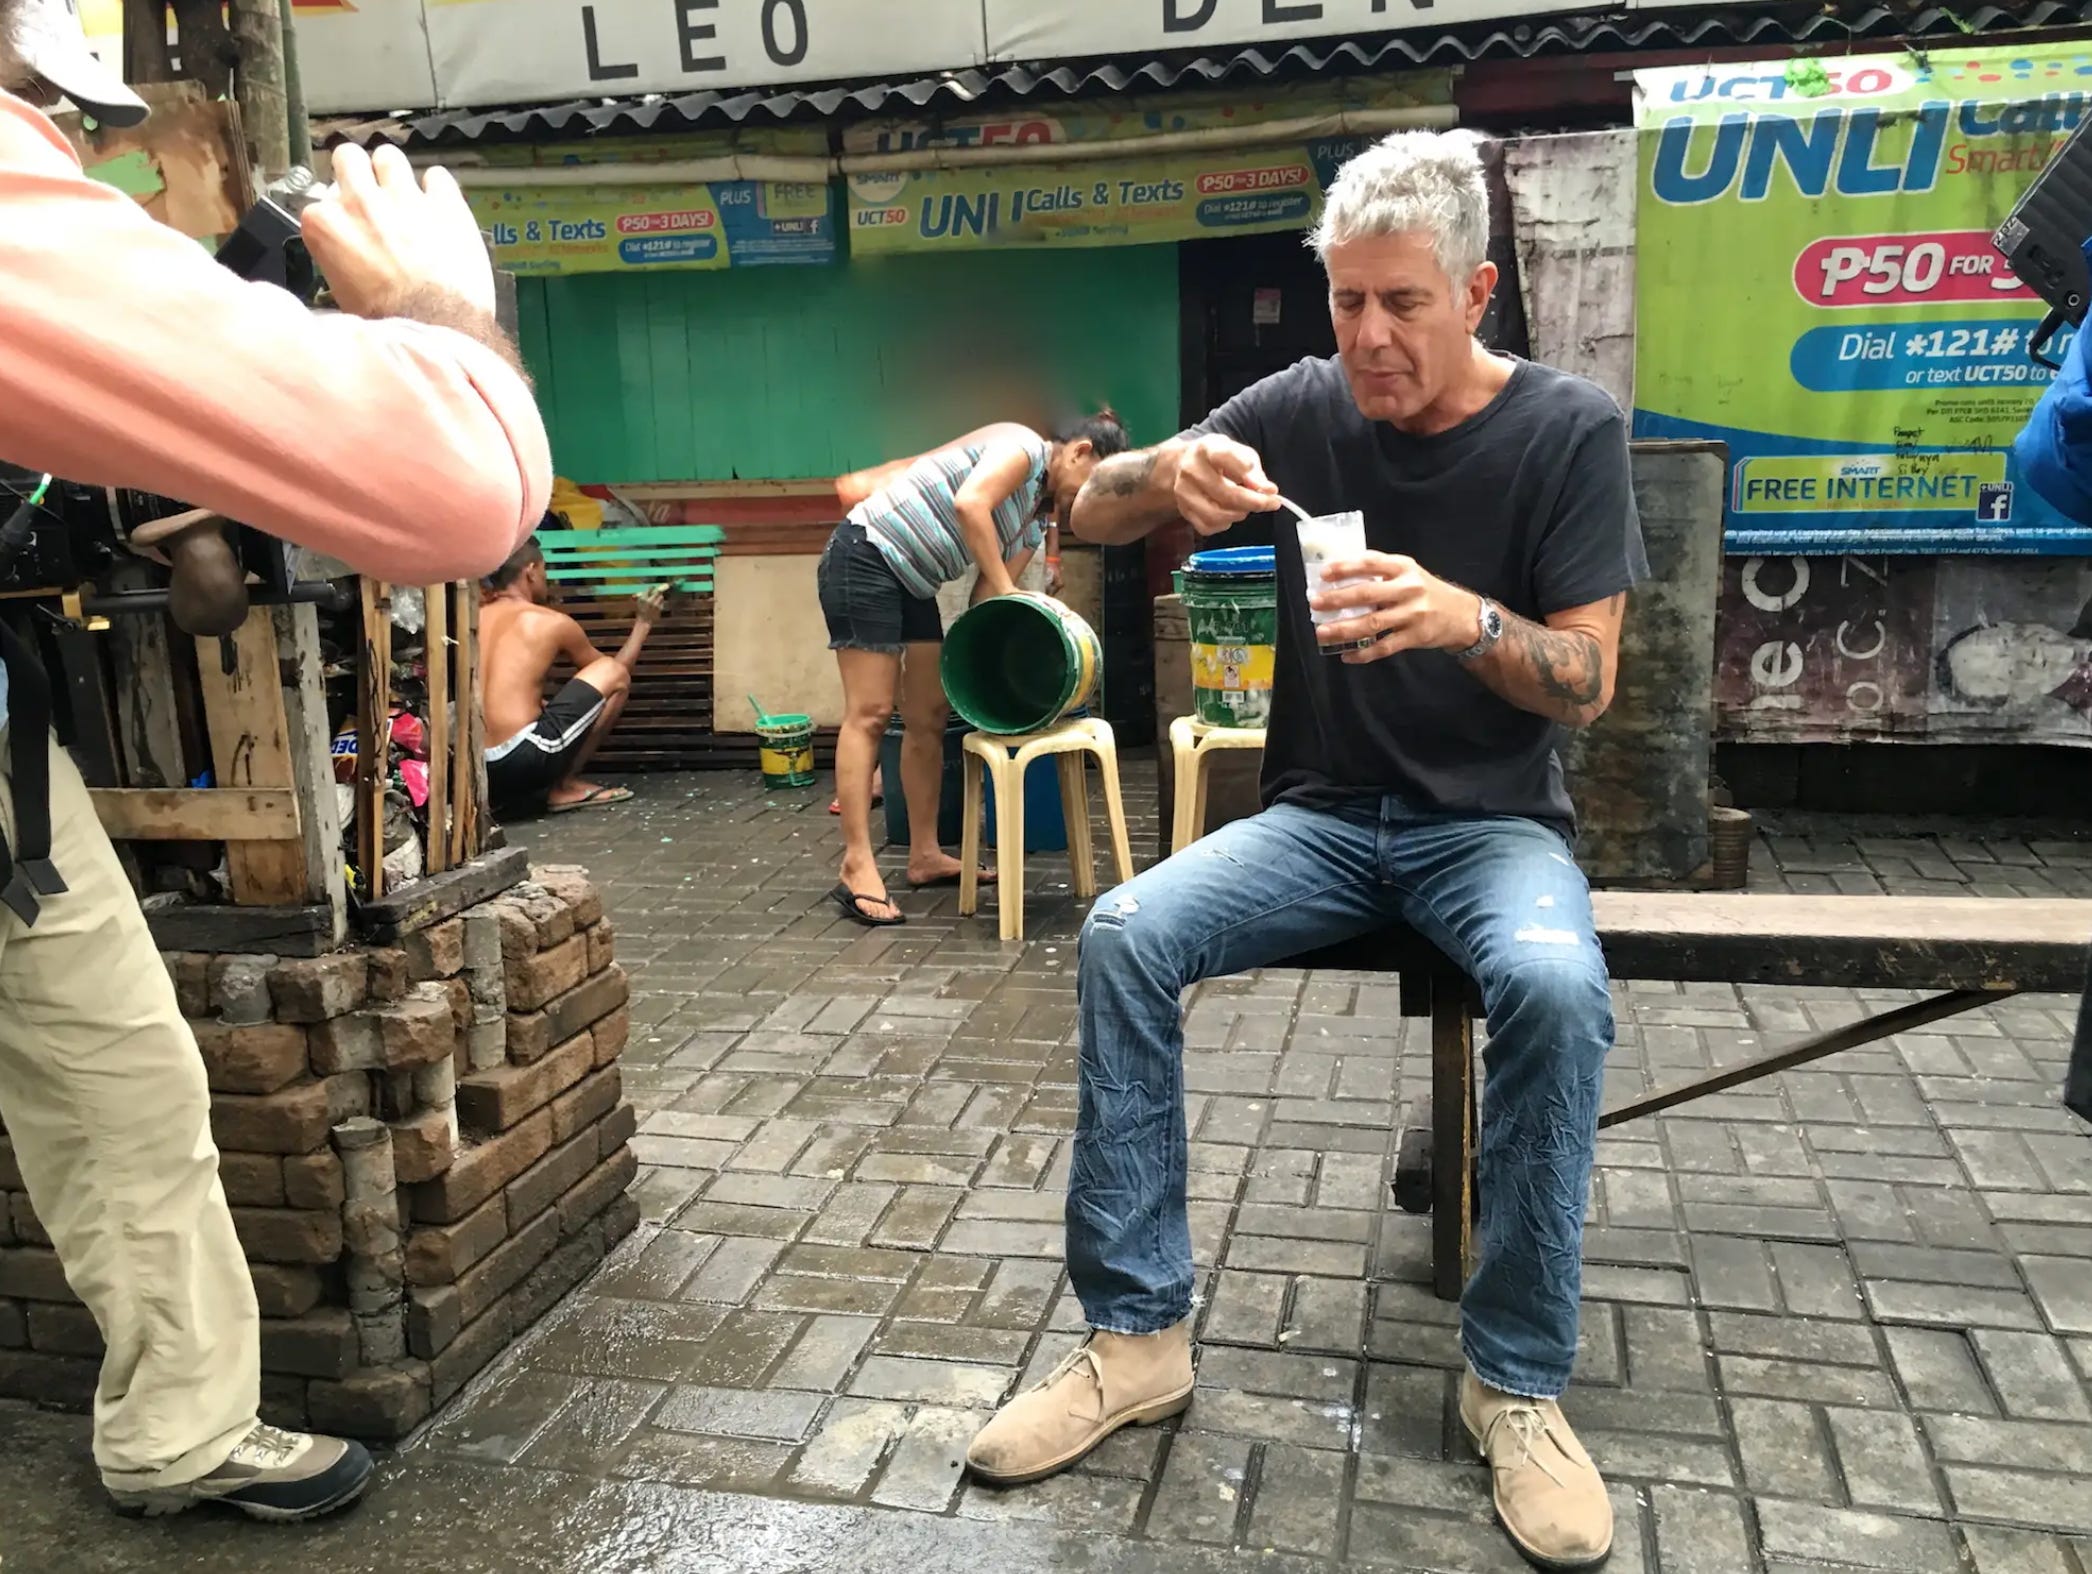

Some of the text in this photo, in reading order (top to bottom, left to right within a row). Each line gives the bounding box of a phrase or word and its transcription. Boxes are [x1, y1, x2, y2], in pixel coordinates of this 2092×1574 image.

[1654, 91, 2084, 204] UNLI Call
[1246, 173, 1256, 188] 3
[1259, 168, 1302, 187] DAYS!
[720, 190, 751, 206] PLUS
[1026, 185, 1083, 212] Calls
[1092, 182, 1109, 205] &
[1119, 178, 1185, 204] Texts
[660, 215, 669, 229] 3
[671, 212, 709, 229] DAYS!
[857, 209, 906, 226] UCT50
[494, 219, 606, 245] lls & Texts
[1949, 254, 1994, 276] FOR
[1838, 332, 1896, 361] Dial
[1905, 366, 2049, 384] or text UCT50 to
[1840, 465, 1882, 477] SMART
[1747, 475, 1978, 501] FREE INTERNET
